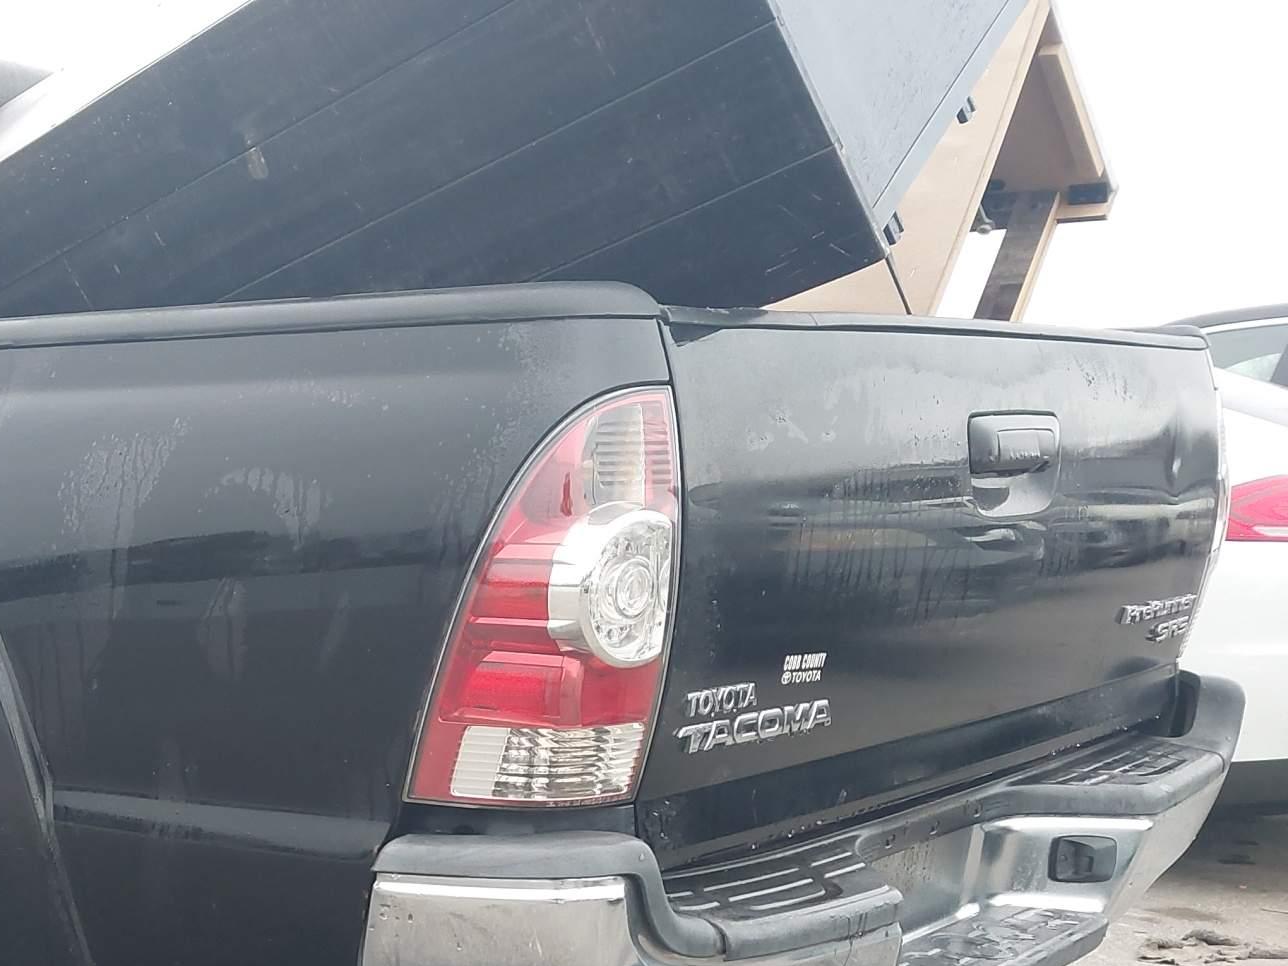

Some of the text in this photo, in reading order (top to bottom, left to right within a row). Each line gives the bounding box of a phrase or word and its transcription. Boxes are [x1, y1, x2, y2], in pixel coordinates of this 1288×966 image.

[783, 652, 827, 671] COBB COUNTY
[792, 669, 821, 684] TOYOTA
[686, 682, 758, 718] TOYOTA
[672, 698, 832, 754] TACOMA
